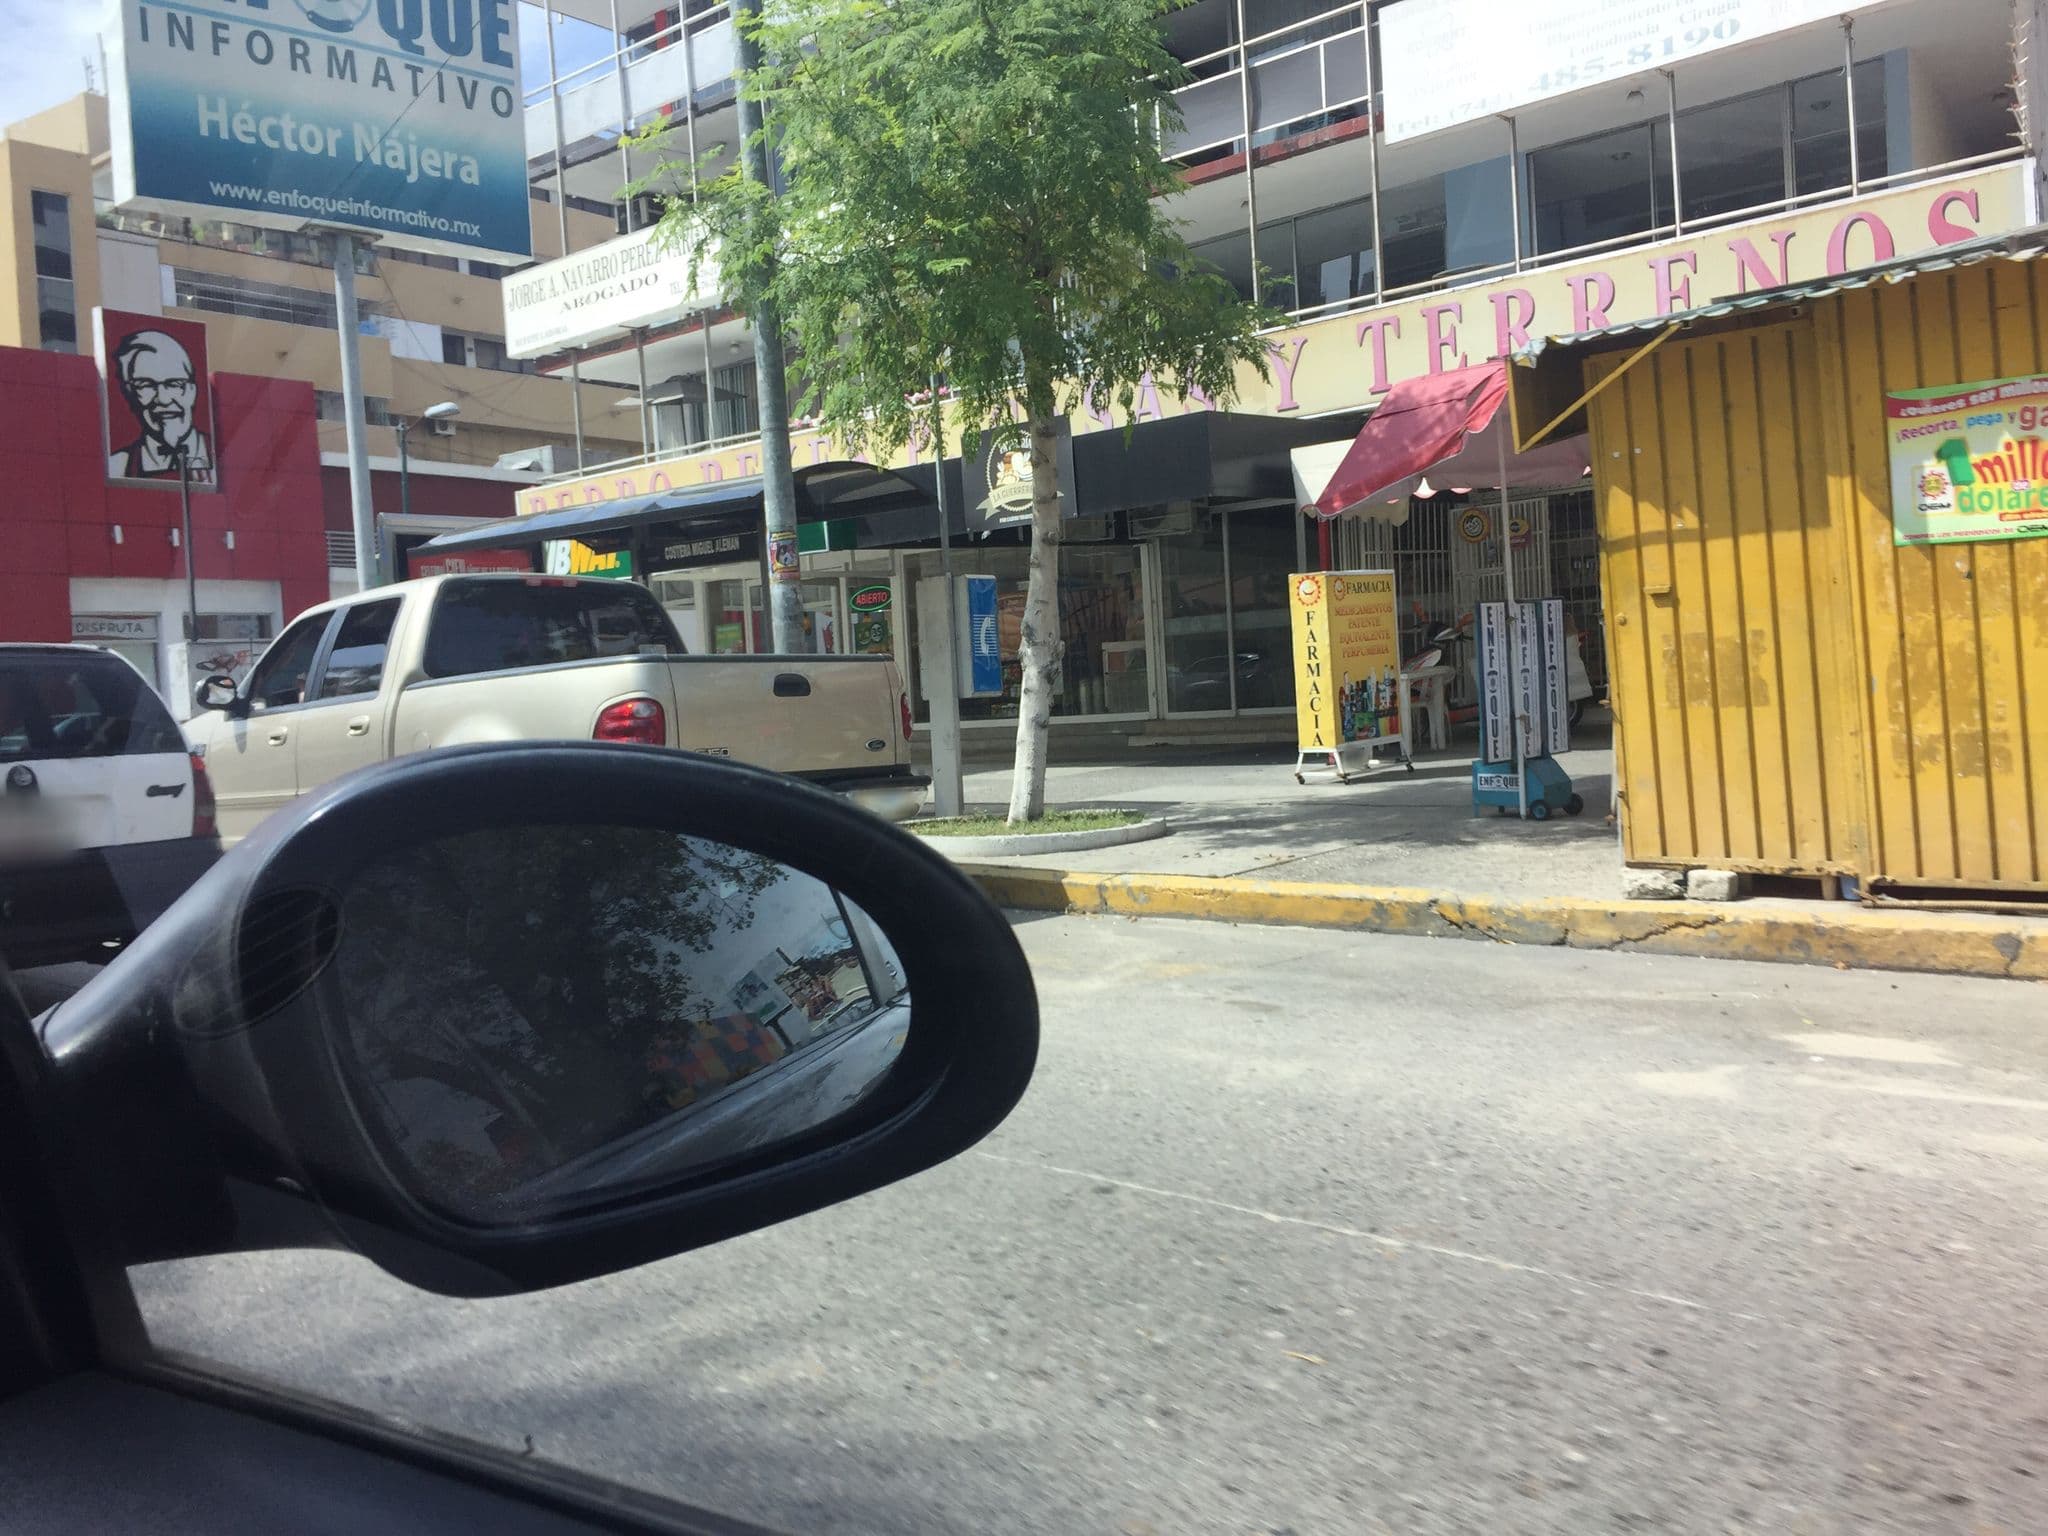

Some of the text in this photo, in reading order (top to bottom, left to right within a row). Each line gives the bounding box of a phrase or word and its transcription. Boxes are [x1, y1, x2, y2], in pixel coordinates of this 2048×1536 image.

[139, 7, 514, 119] INFORMATIVO
[197, 95, 480, 186] Héctor Nájera
[209, 180, 481, 238] www.enfoqueinformativo.mx
[508, 275, 546, 311] JORGE
[562, 254, 618, 293] NAVARRO
[560, 272, 659, 314] ABOGADO
[1269, 336, 1308, 413] Y
[1357, 189, 1980, 395] TERRENOS
[1935, 438, 1976, 487] 1
[855, 590, 888, 607] ABIERTO
[1346, 580, 1392, 595] FARMACIA
[75, 621, 145, 634] DISFRUTA
[1305, 611, 1325, 747] FARMACIA
